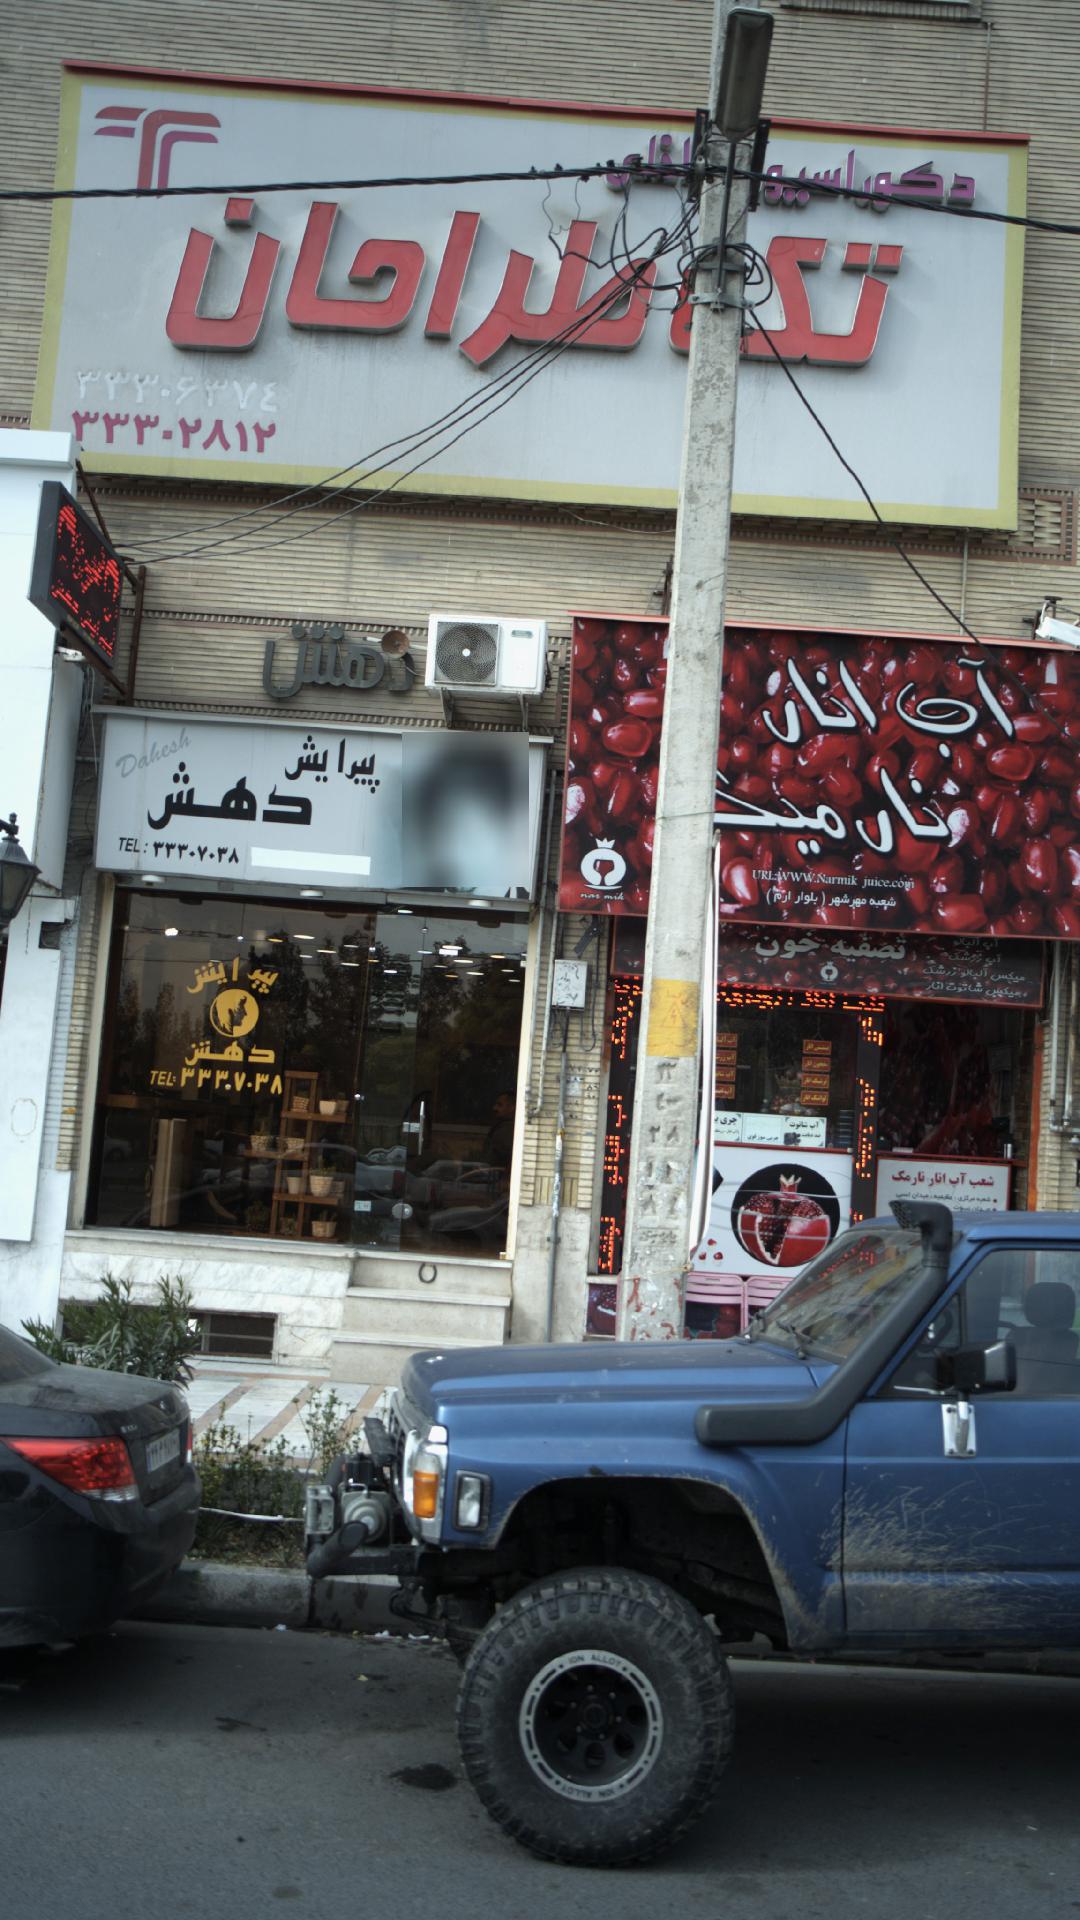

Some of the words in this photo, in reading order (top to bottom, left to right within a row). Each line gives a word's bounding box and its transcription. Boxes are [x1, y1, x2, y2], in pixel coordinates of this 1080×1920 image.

[762, 149, 977, 214] دکوراسیو
[165, 198, 657, 367] طراحان
[71, 410, 277, 453] ۳۳۳۰۲۸۱۲
[761, 655, 878, 744] انار
[115, 727, 191, 778] Dahesh
[147, 761, 312, 830] دهش
[152, 840, 240, 864] ۳۳۳۰۷۰۳۸
[755, 931, 820, 959] خون
[830, 932, 906, 963] تصفیه
[185, 1040, 276, 1066] دهش
[180, 1067, 283, 1095] ۳۳۳۰۷۰۳۸
[928, 1171, 947, 1186] انار
